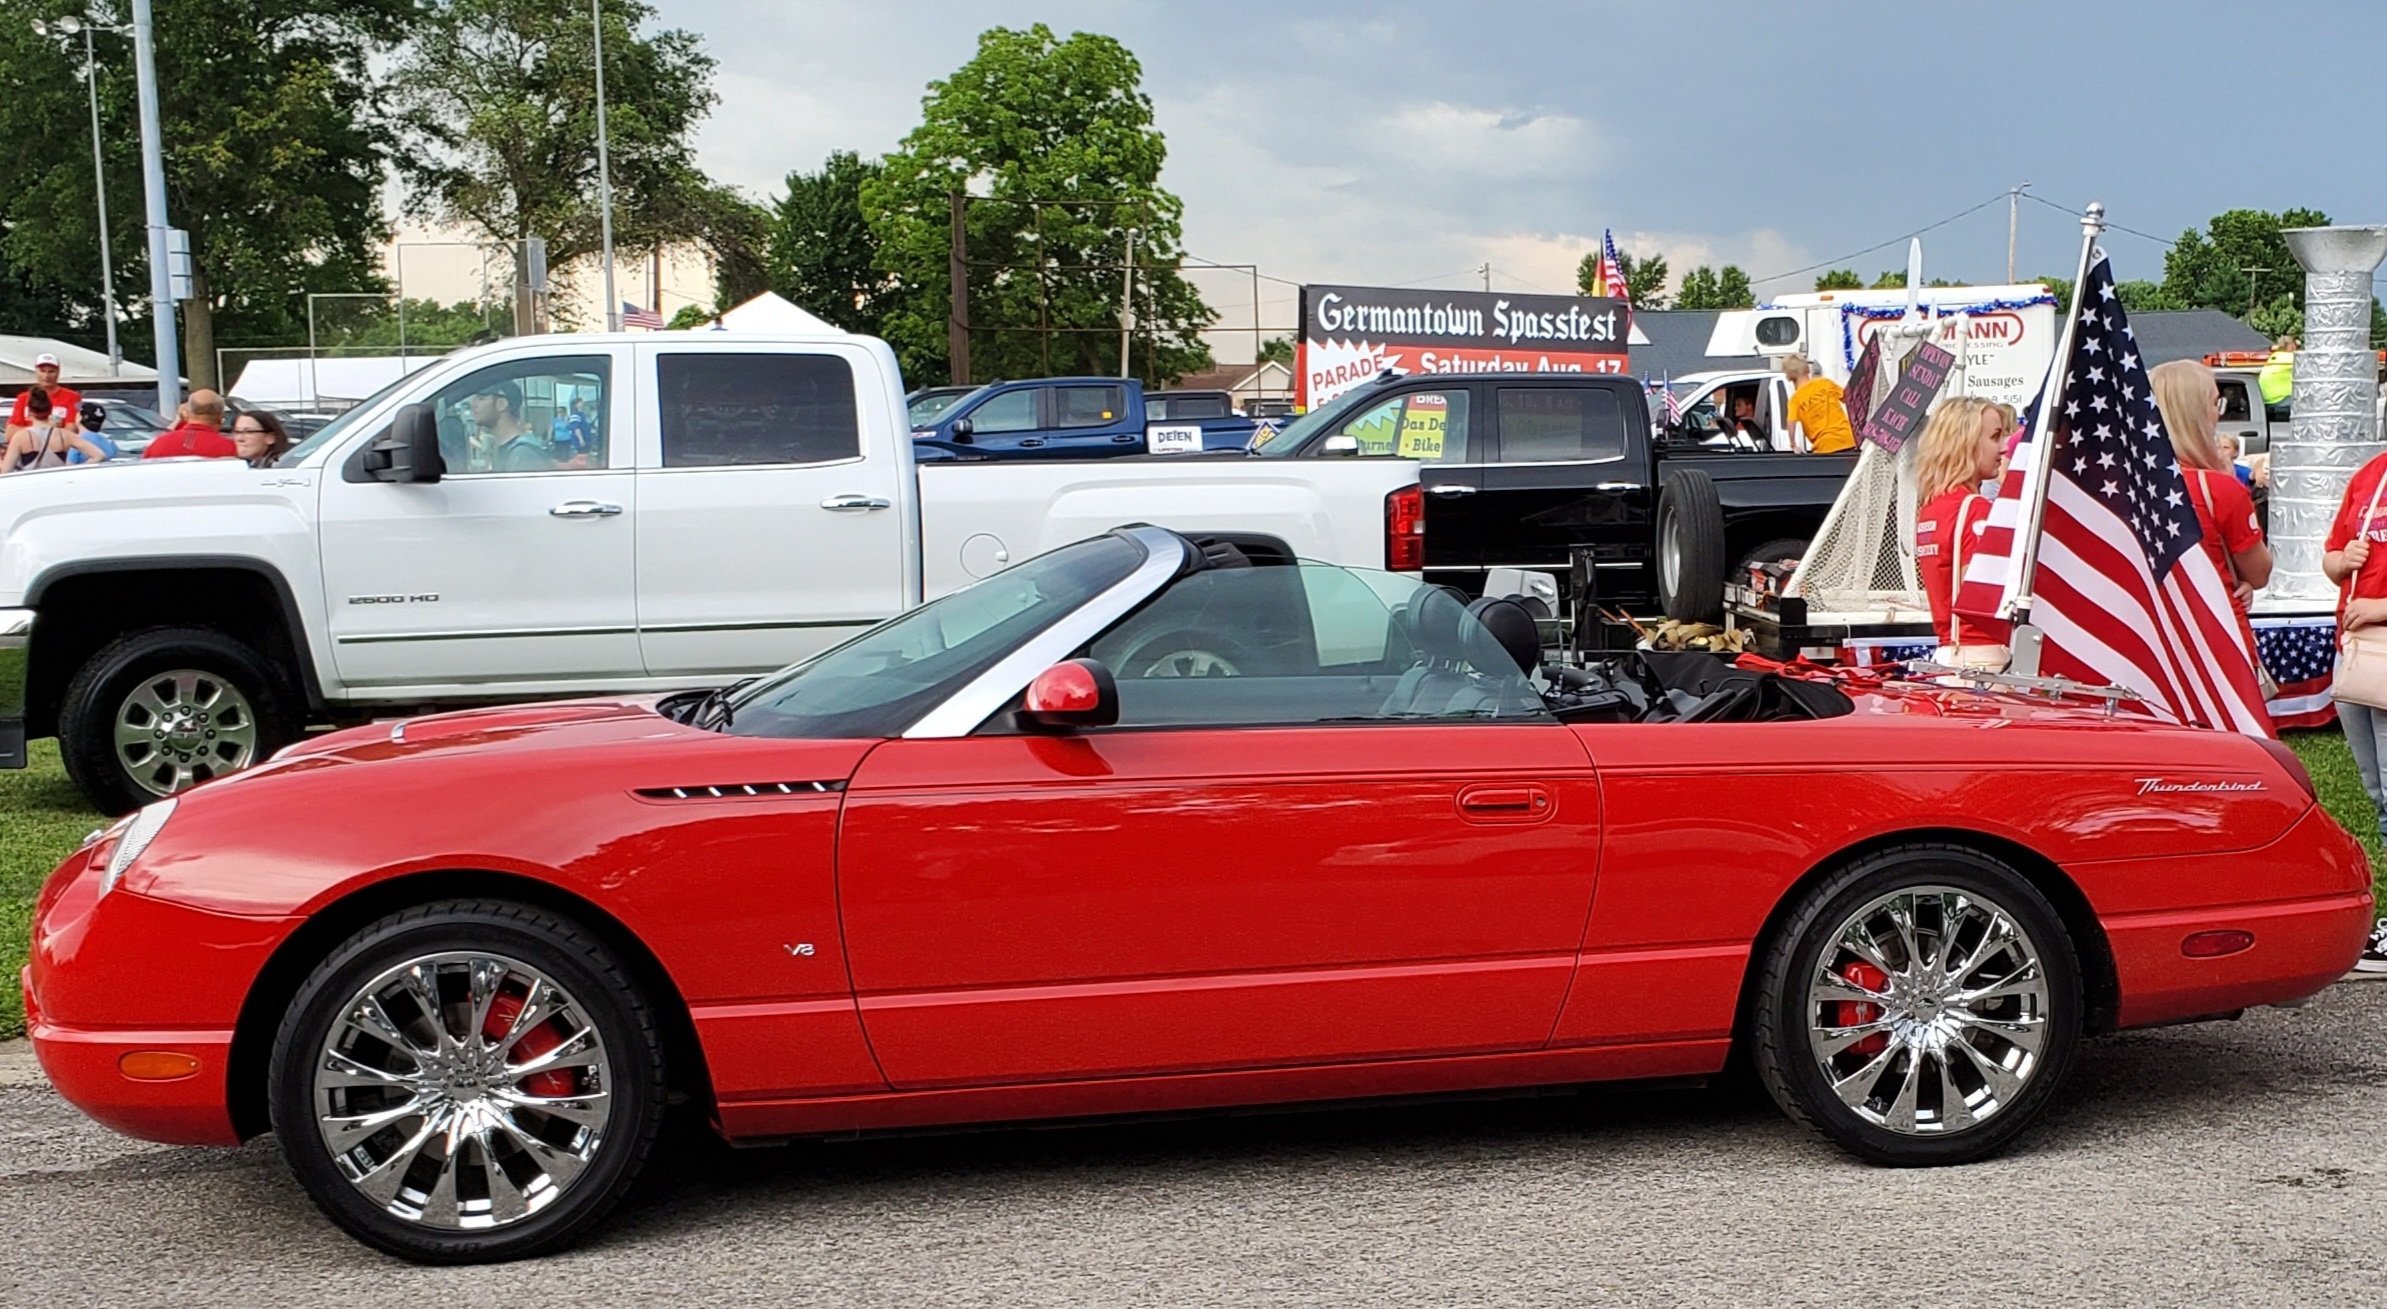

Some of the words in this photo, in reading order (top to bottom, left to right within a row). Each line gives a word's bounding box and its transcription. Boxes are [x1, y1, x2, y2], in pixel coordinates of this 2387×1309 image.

[1317, 292, 1485, 337] Germantown
[1492, 300, 1617, 345] Spassfest
[1312, 353, 1384, 392] PARADE
[1967, 375, 2024, 389] Sausages
[1412, 437, 1441, 452] Bike
[348, 594, 405, 605] 2500
[409, 592, 440, 603] HD
[2134, 777, 2269, 796] Thunderbird
[783, 943, 816, 956] V8
